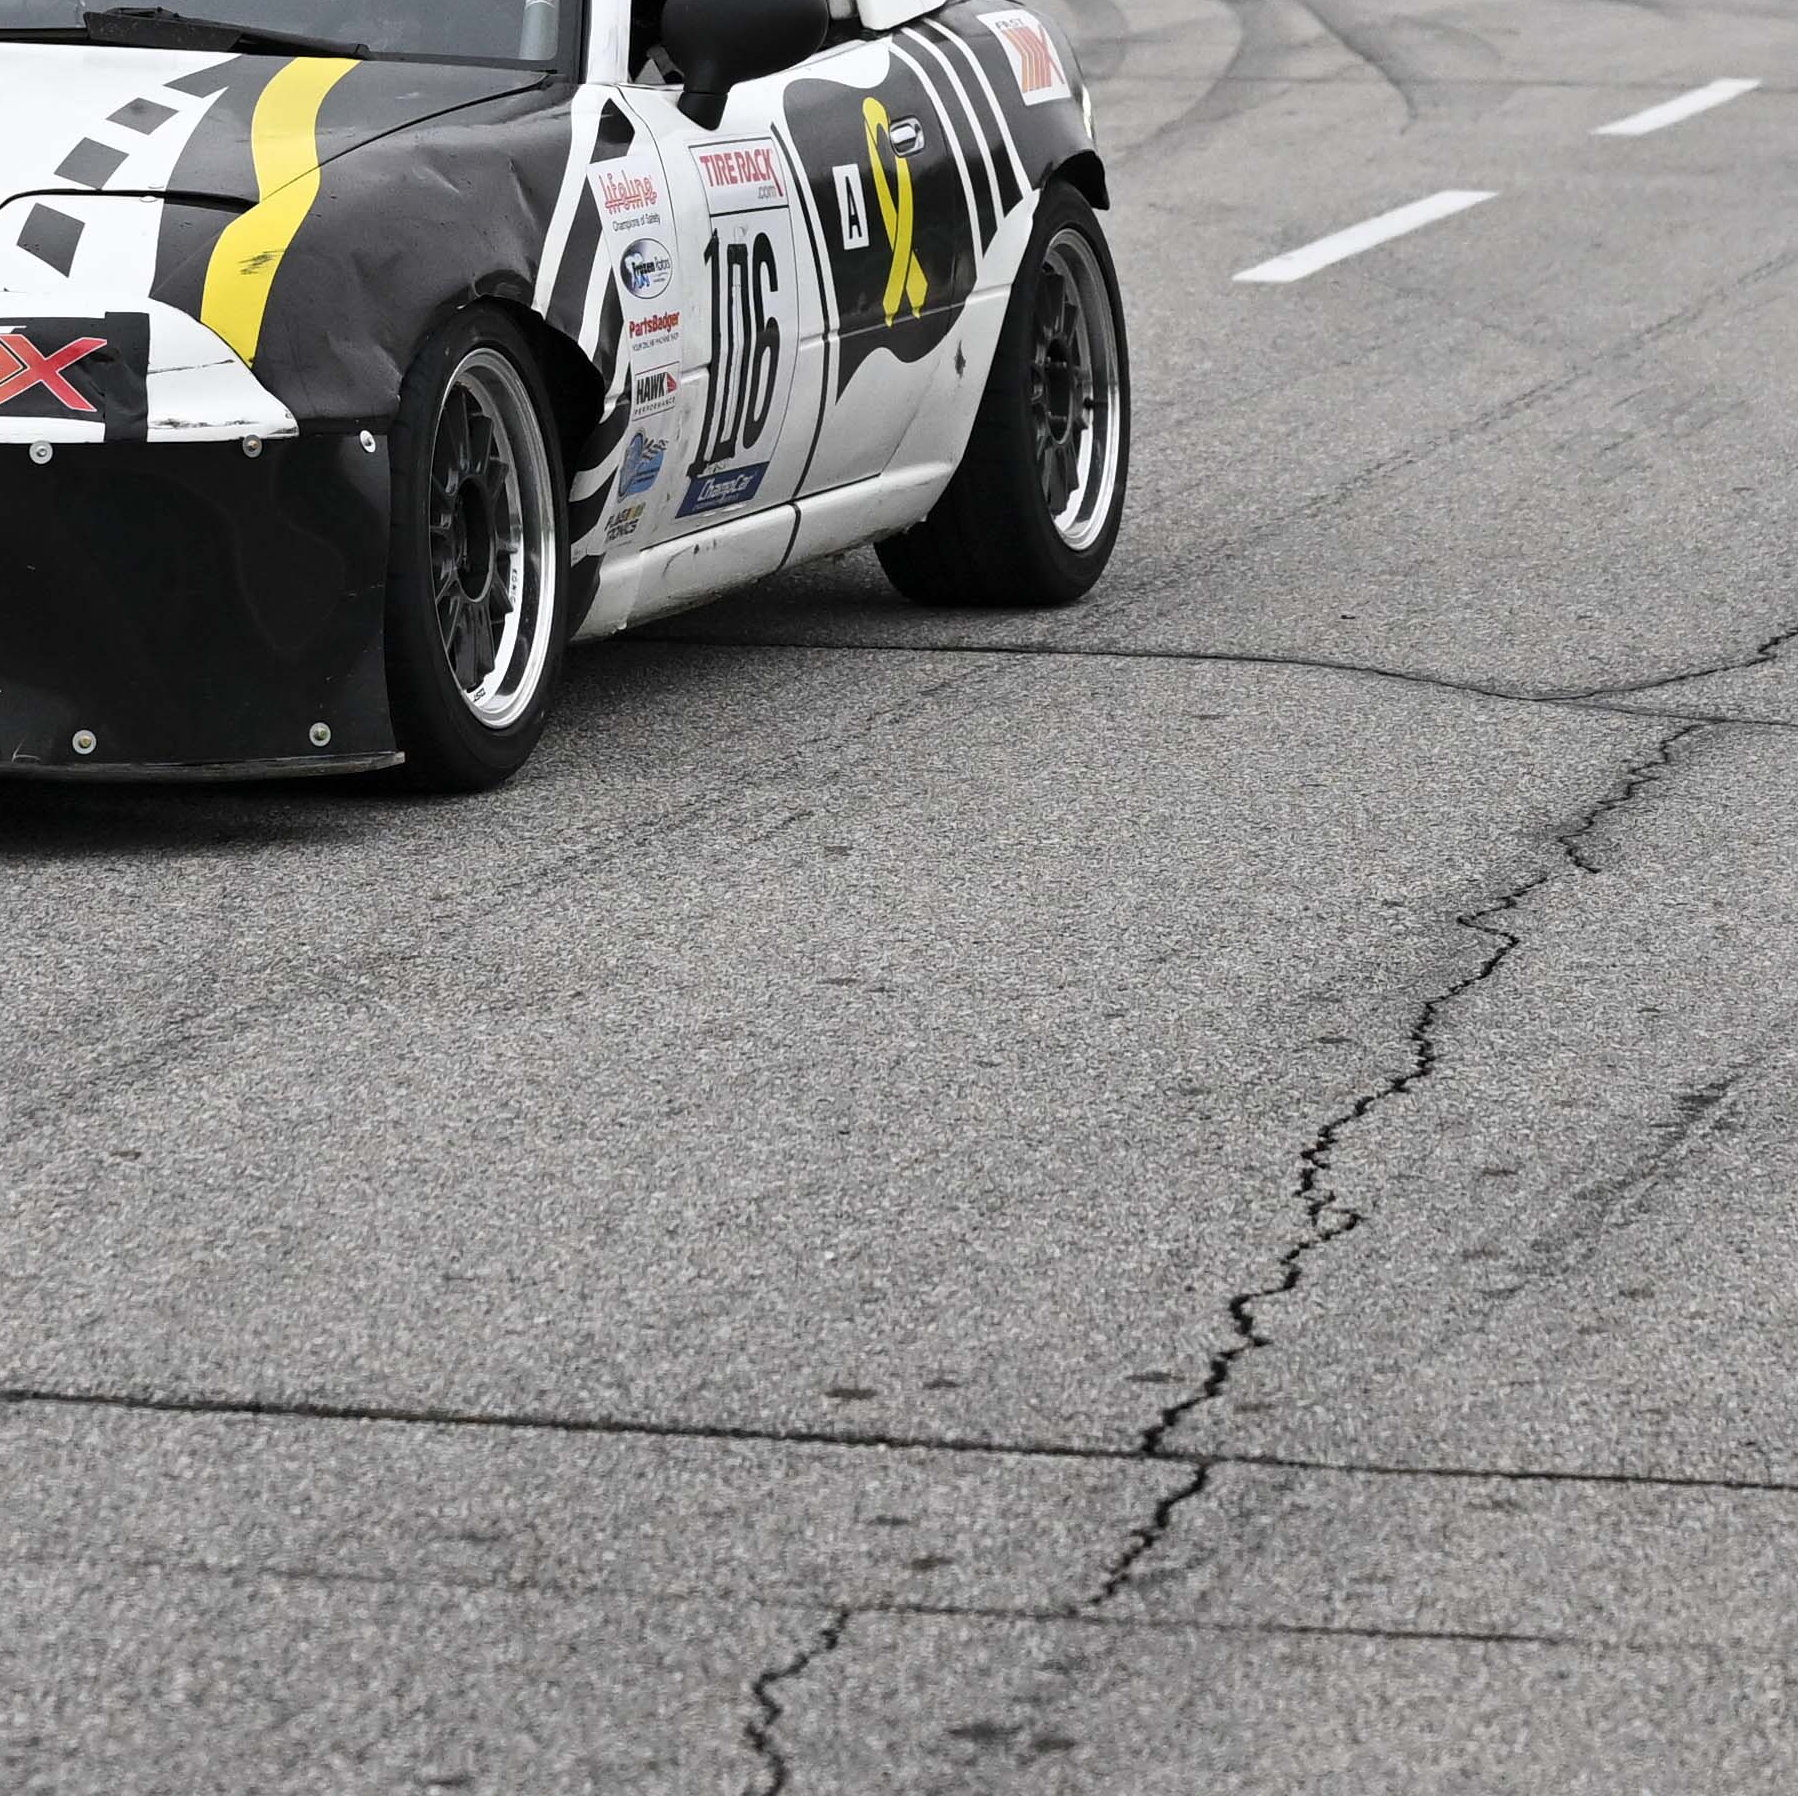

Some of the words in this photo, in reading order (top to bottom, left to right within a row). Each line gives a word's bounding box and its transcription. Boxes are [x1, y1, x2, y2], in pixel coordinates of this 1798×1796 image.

[699, 152, 738, 187] TIRE
[734, 148, 783, 197] RACK
[758, 185, 777, 200] .com
[845, 175, 863, 240] A
[629, 311, 680, 339] PartsBadger
[688, 229, 780, 478] 106
[634, 395, 676, 415] PERFORMANCE
[636, 372, 666, 405] HAWK
